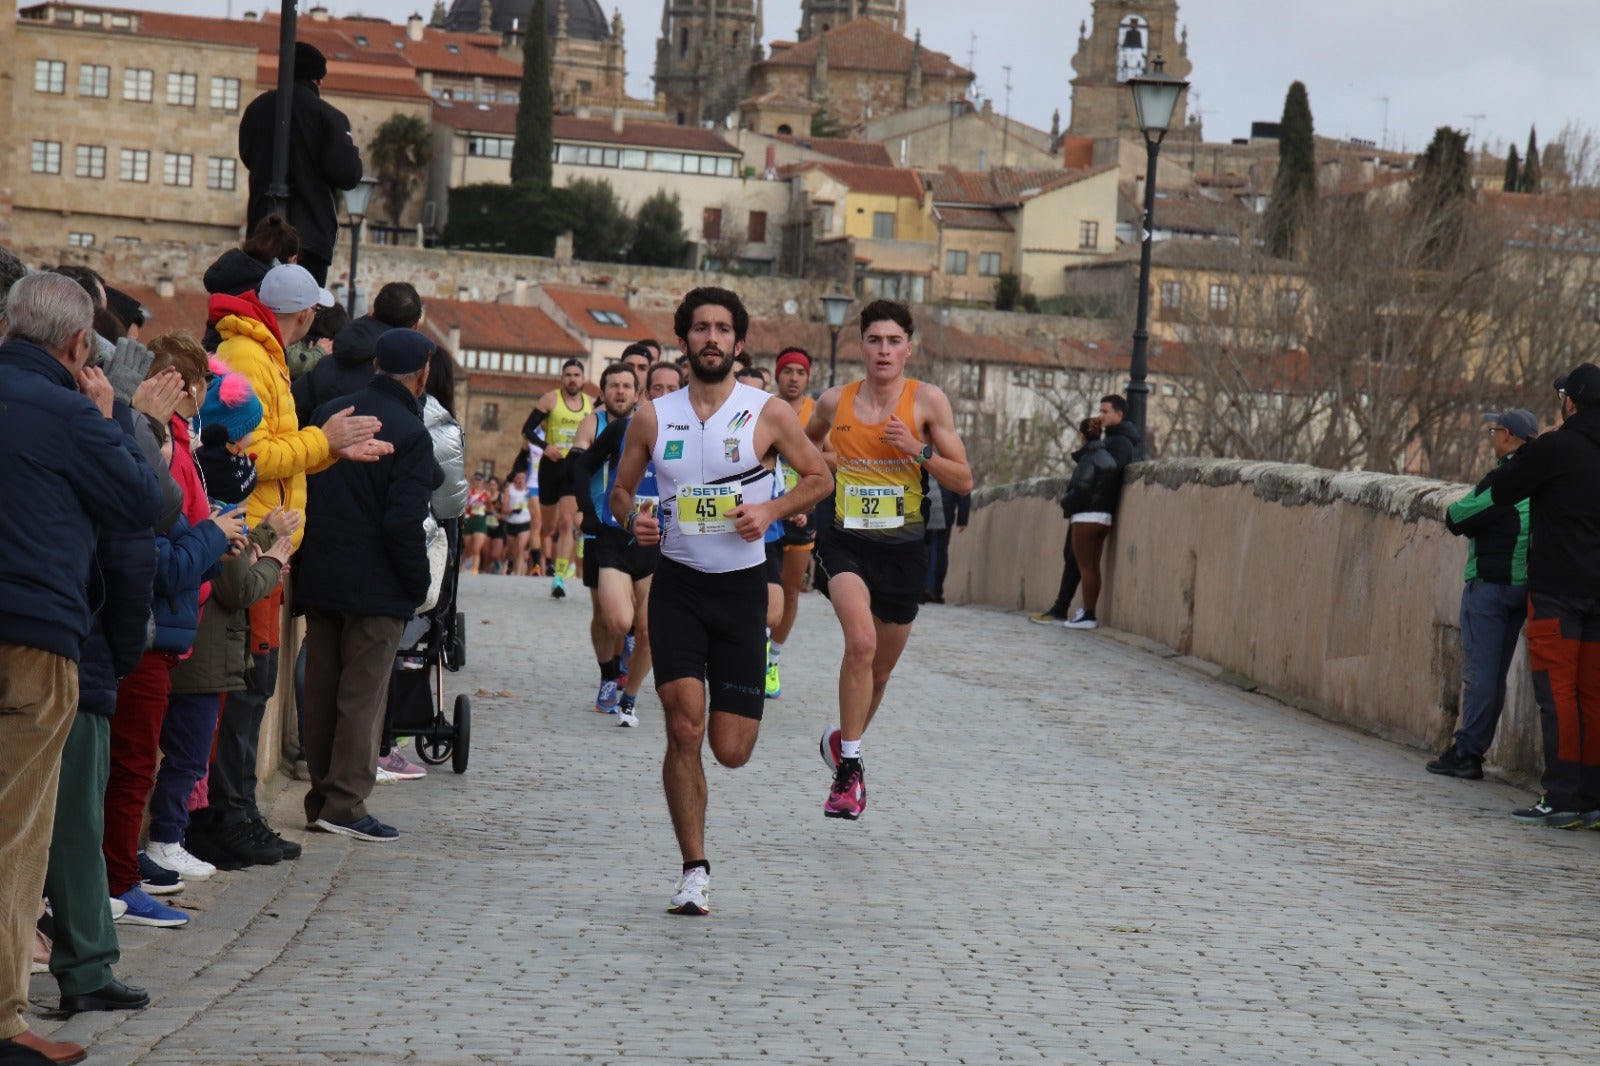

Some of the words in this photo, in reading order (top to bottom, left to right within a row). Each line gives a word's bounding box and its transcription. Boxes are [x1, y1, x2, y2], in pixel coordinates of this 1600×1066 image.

[692, 486, 736, 496] SETEL
[859, 488, 898, 496] SETEL
[695, 498, 717, 517] 45
[861, 497, 880, 515] 32
